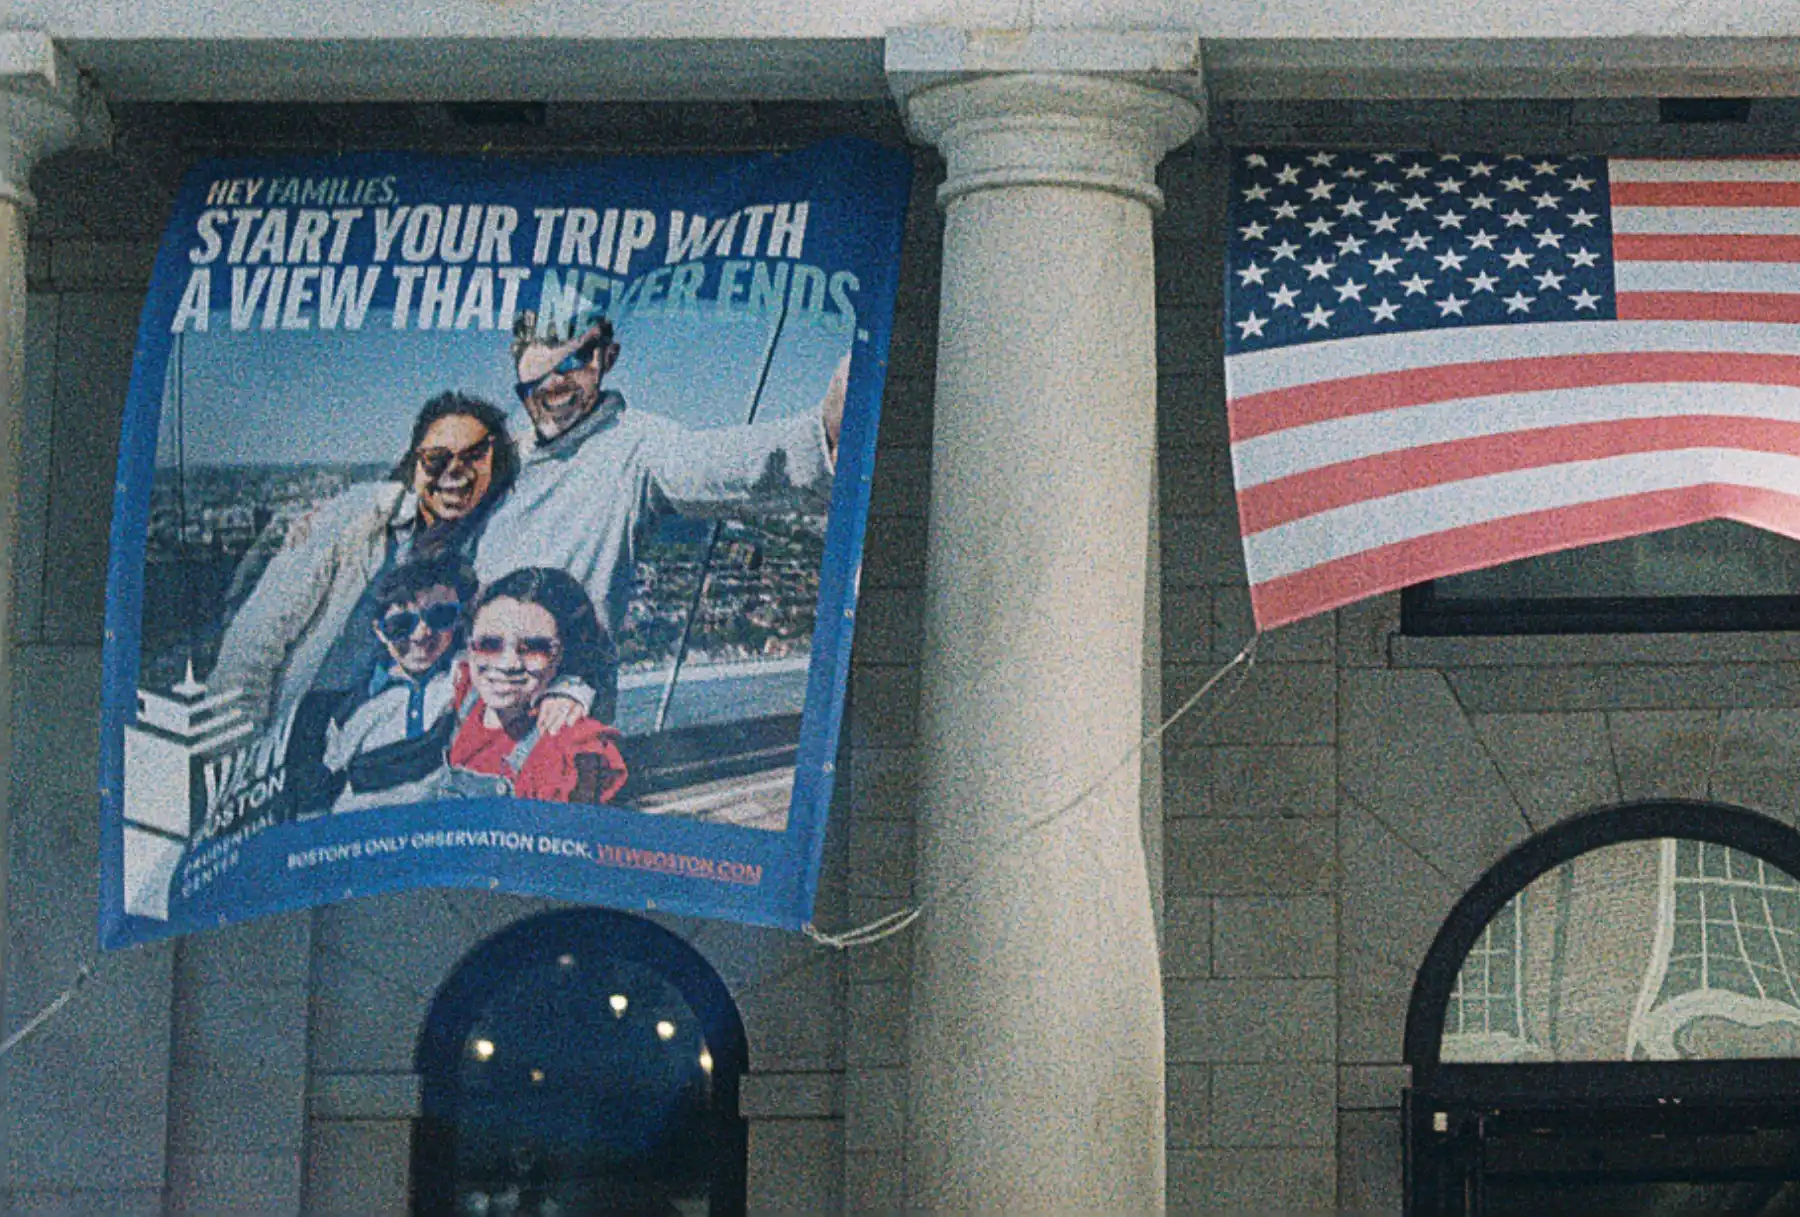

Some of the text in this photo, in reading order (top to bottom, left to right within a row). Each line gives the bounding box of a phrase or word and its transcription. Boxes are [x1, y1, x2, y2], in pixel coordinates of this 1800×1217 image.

[206, 176, 400, 205] HEY FAMILIES,
[189, 201, 810, 275] START YOUR TRIP WITH
[172, 267, 209, 333] A
[232, 266, 381, 332] VIEW
[391, 267, 531, 332] THAT
[536, 262, 706, 340] NEVER
[365, 834, 408, 856] ONLY
